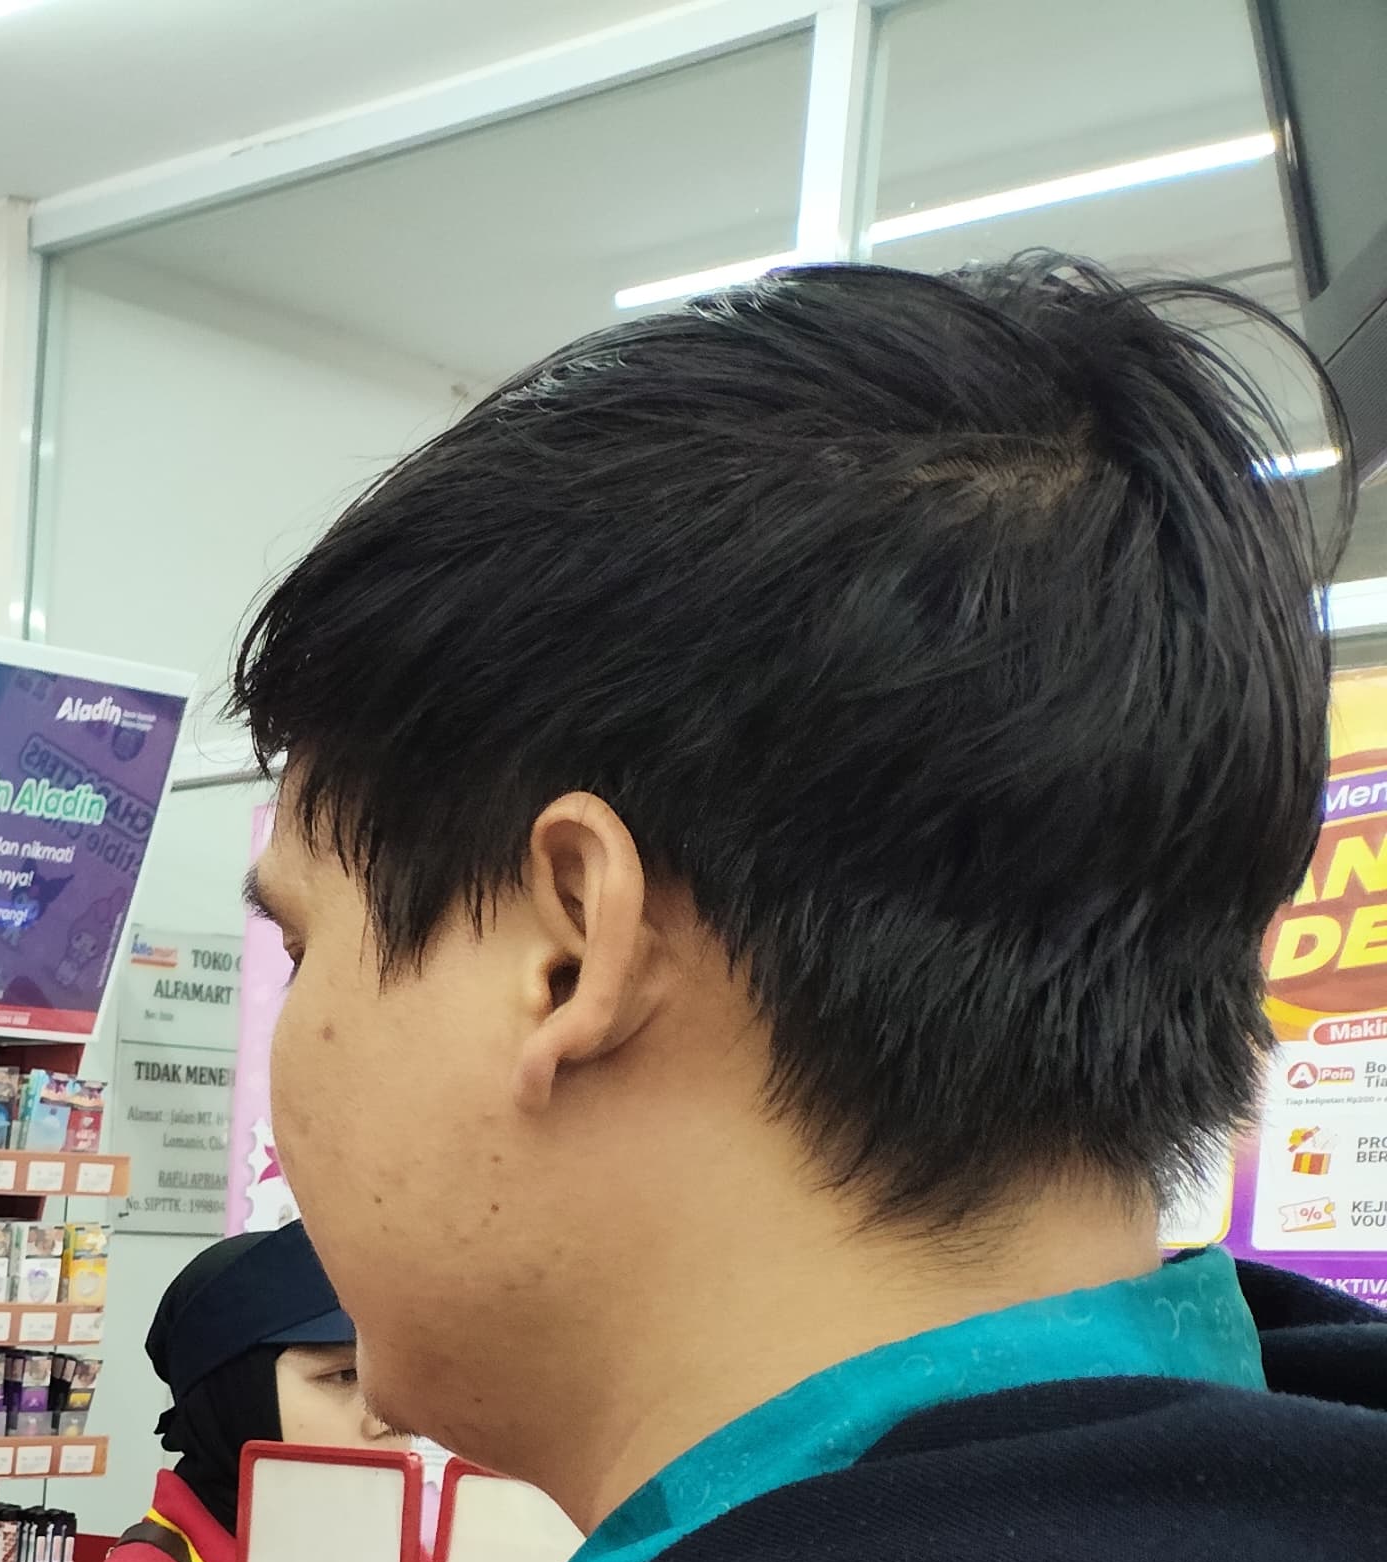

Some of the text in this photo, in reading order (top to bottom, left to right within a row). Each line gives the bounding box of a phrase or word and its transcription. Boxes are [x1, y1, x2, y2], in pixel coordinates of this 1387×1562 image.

[56, 697, 122, 724] Aladin
[12, 778, 107, 826] Aladin
[21, 841, 75, 863] nikmati
[191, 950, 232, 972] TOKO
[153, 979, 233, 1004] ALFAMART
[134, 1061, 181, 1083] TIDAK
[1320, 1067, 1354, 1081] Poin
